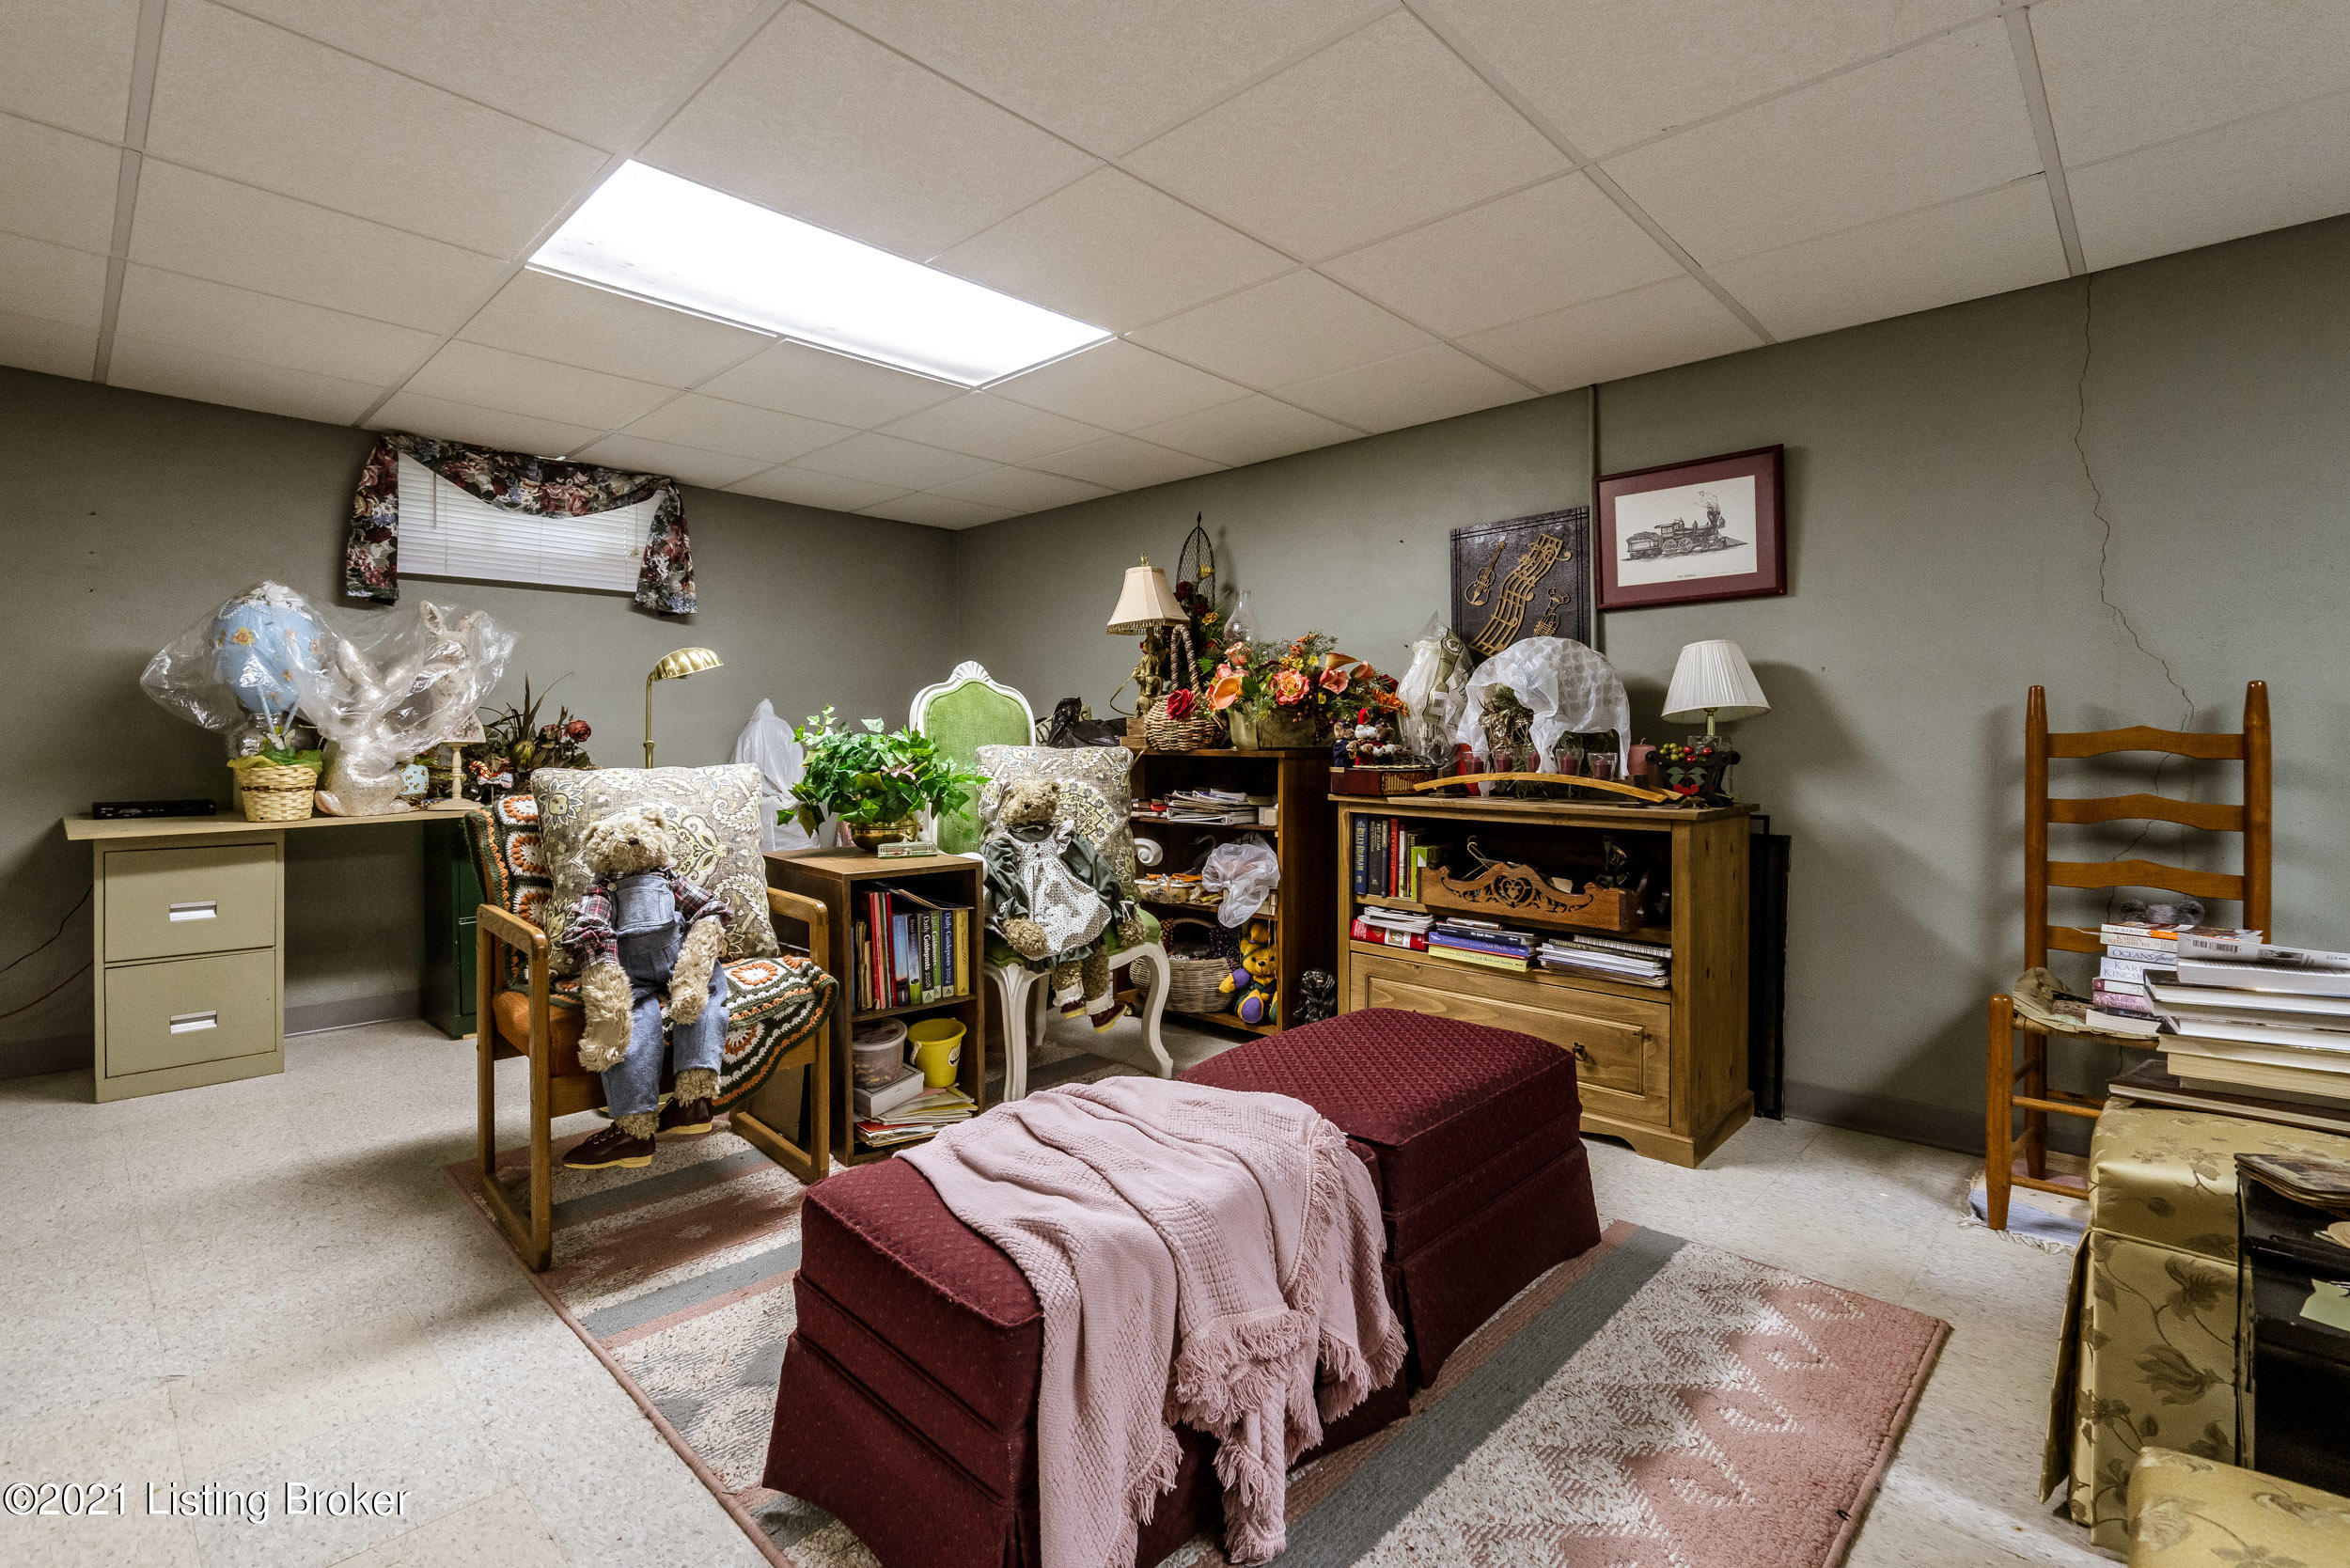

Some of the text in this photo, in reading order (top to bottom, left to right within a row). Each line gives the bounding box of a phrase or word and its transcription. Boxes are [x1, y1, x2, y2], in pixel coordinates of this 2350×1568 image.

[923, 934, 932, 971] Guideposts
[944, 931, 952, 966] Guideposts
[2112, 949, 2153, 960] OCEANS
